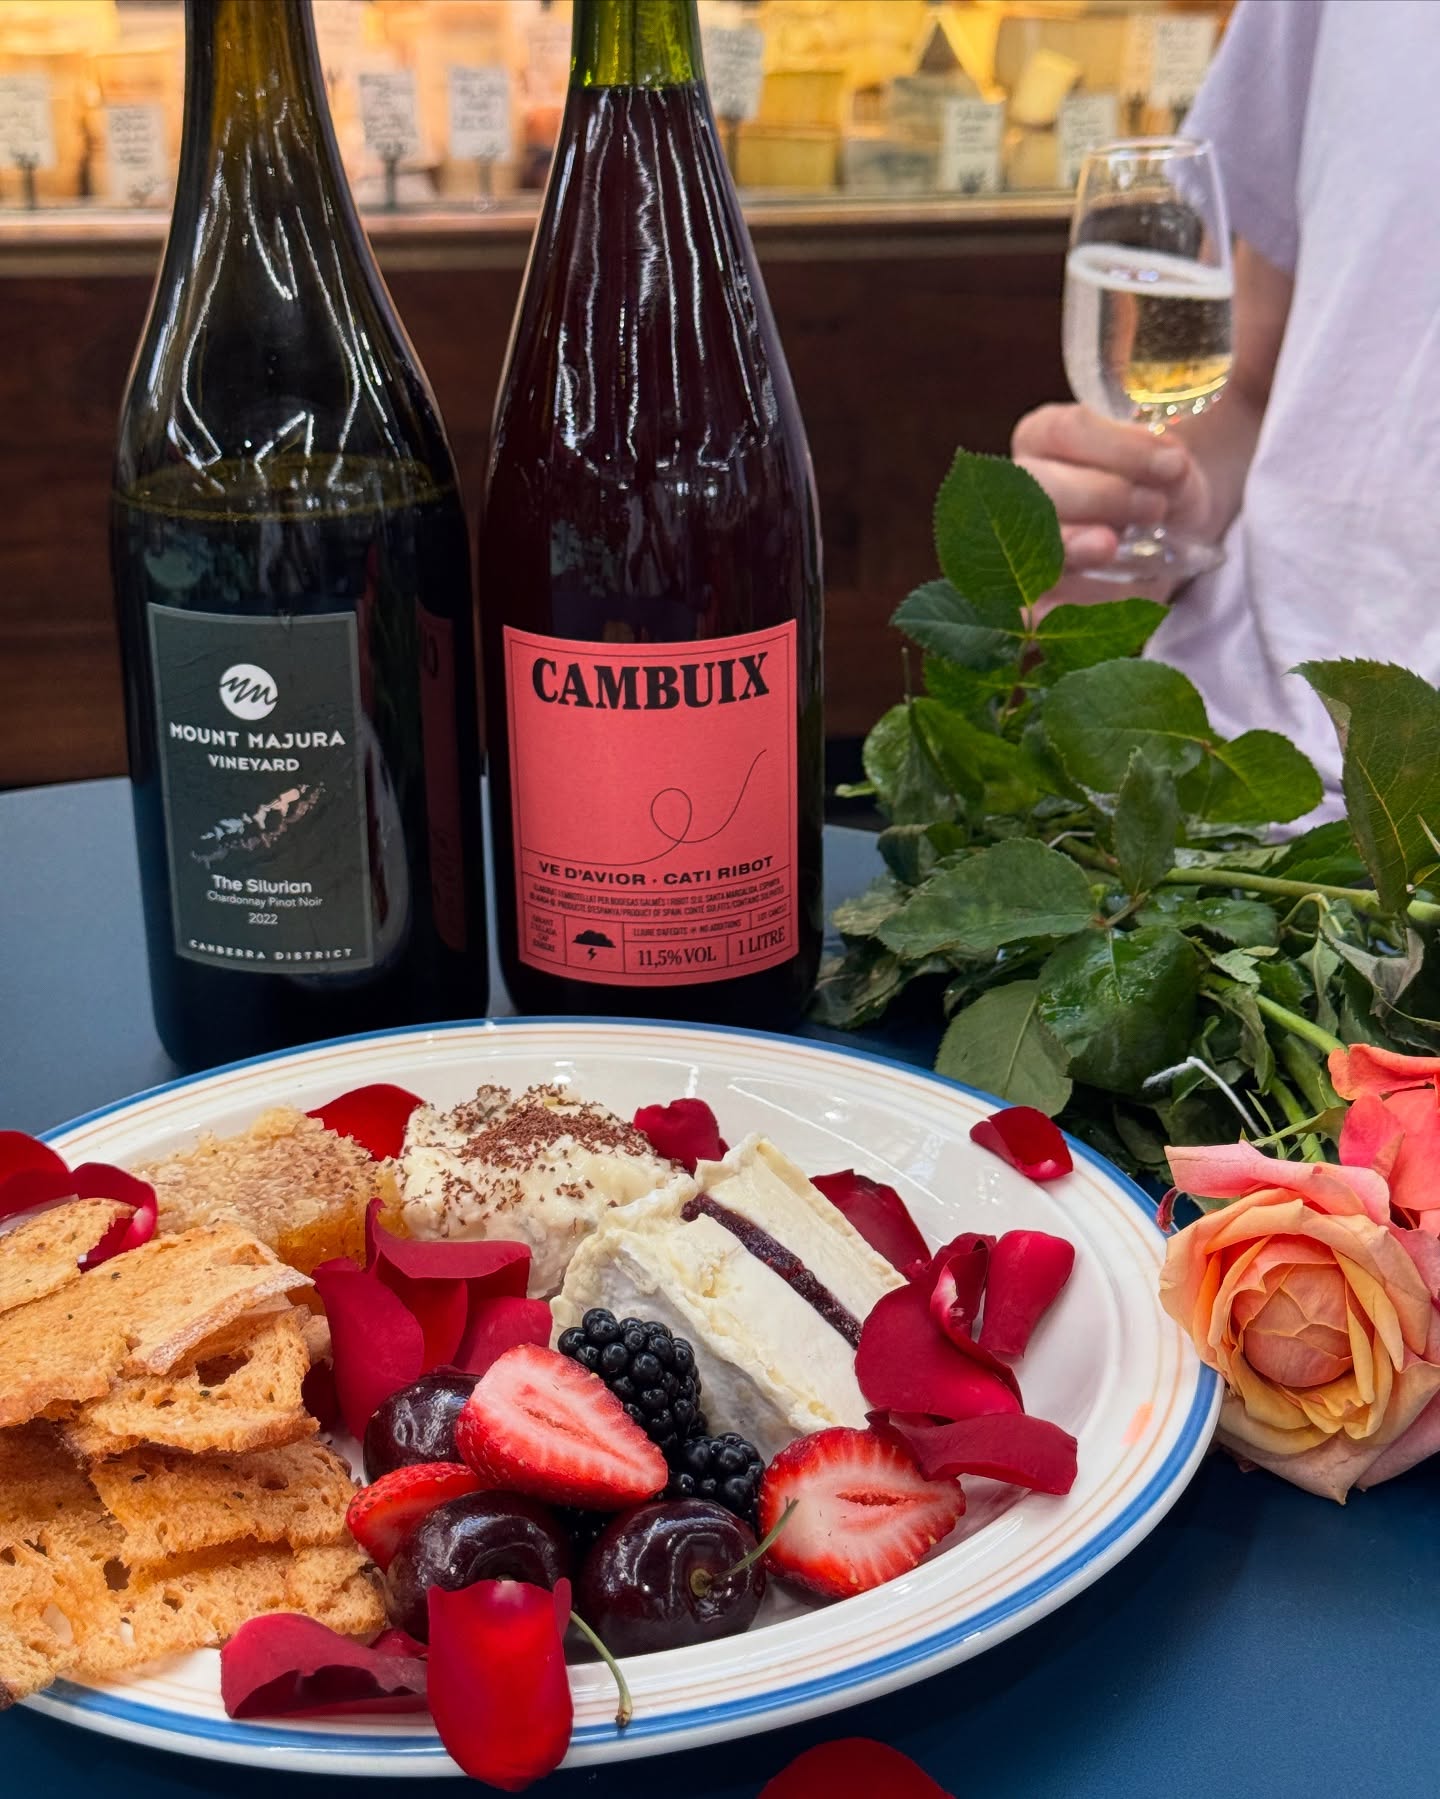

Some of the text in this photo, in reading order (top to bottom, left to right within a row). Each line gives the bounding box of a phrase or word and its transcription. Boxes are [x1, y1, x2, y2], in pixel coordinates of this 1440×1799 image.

[532, 652, 770, 709] CAMBUIX
[169, 722, 346, 749] MOUNT MAJURA
[208, 753, 300, 772] VINEYARD
[539, 855, 773, 885] VE D'AVIOR CATI RIBOT
[211, 874, 313, 894] The Silurian
[207, 890, 323, 908] Chardonnay Pinot Noir
[248, 912, 279, 925] 2022
[188, 939, 353, 960] CANBERRA DISTRICT
[739, 926, 785, 956] 1 LITRE
[638, 945, 717, 968] 11,5% VOL
